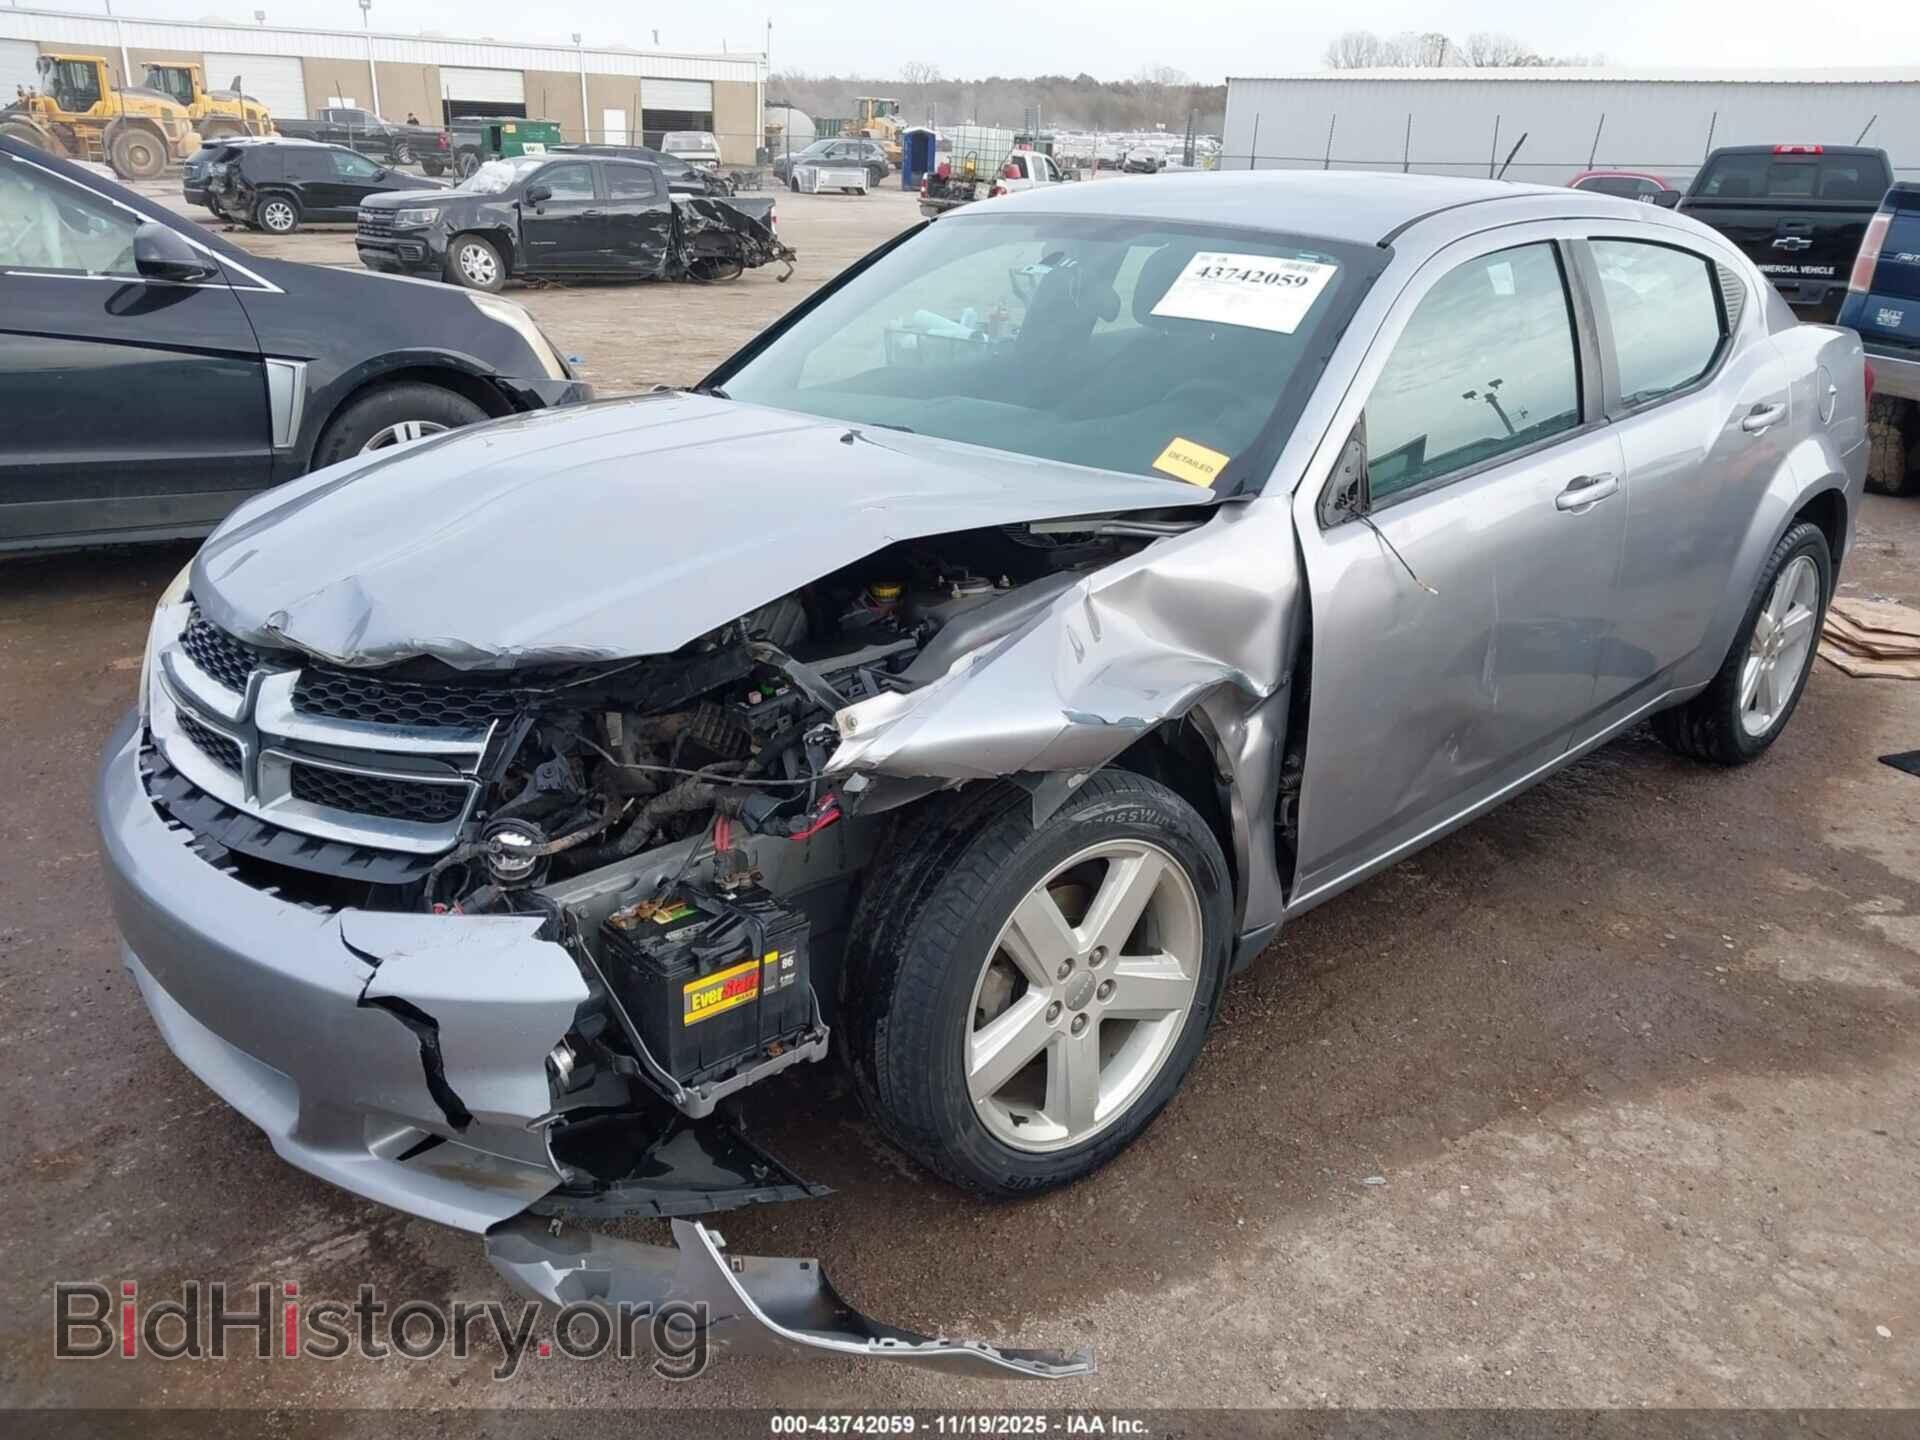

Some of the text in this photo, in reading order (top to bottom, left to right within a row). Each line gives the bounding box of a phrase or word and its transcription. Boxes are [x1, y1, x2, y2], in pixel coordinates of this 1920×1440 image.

[1195, 265, 1309, 288] 43742059
[1758, 264, 1835, 275] MMERCIAL VEHICLE
[781, 955, 795, 969] 86
